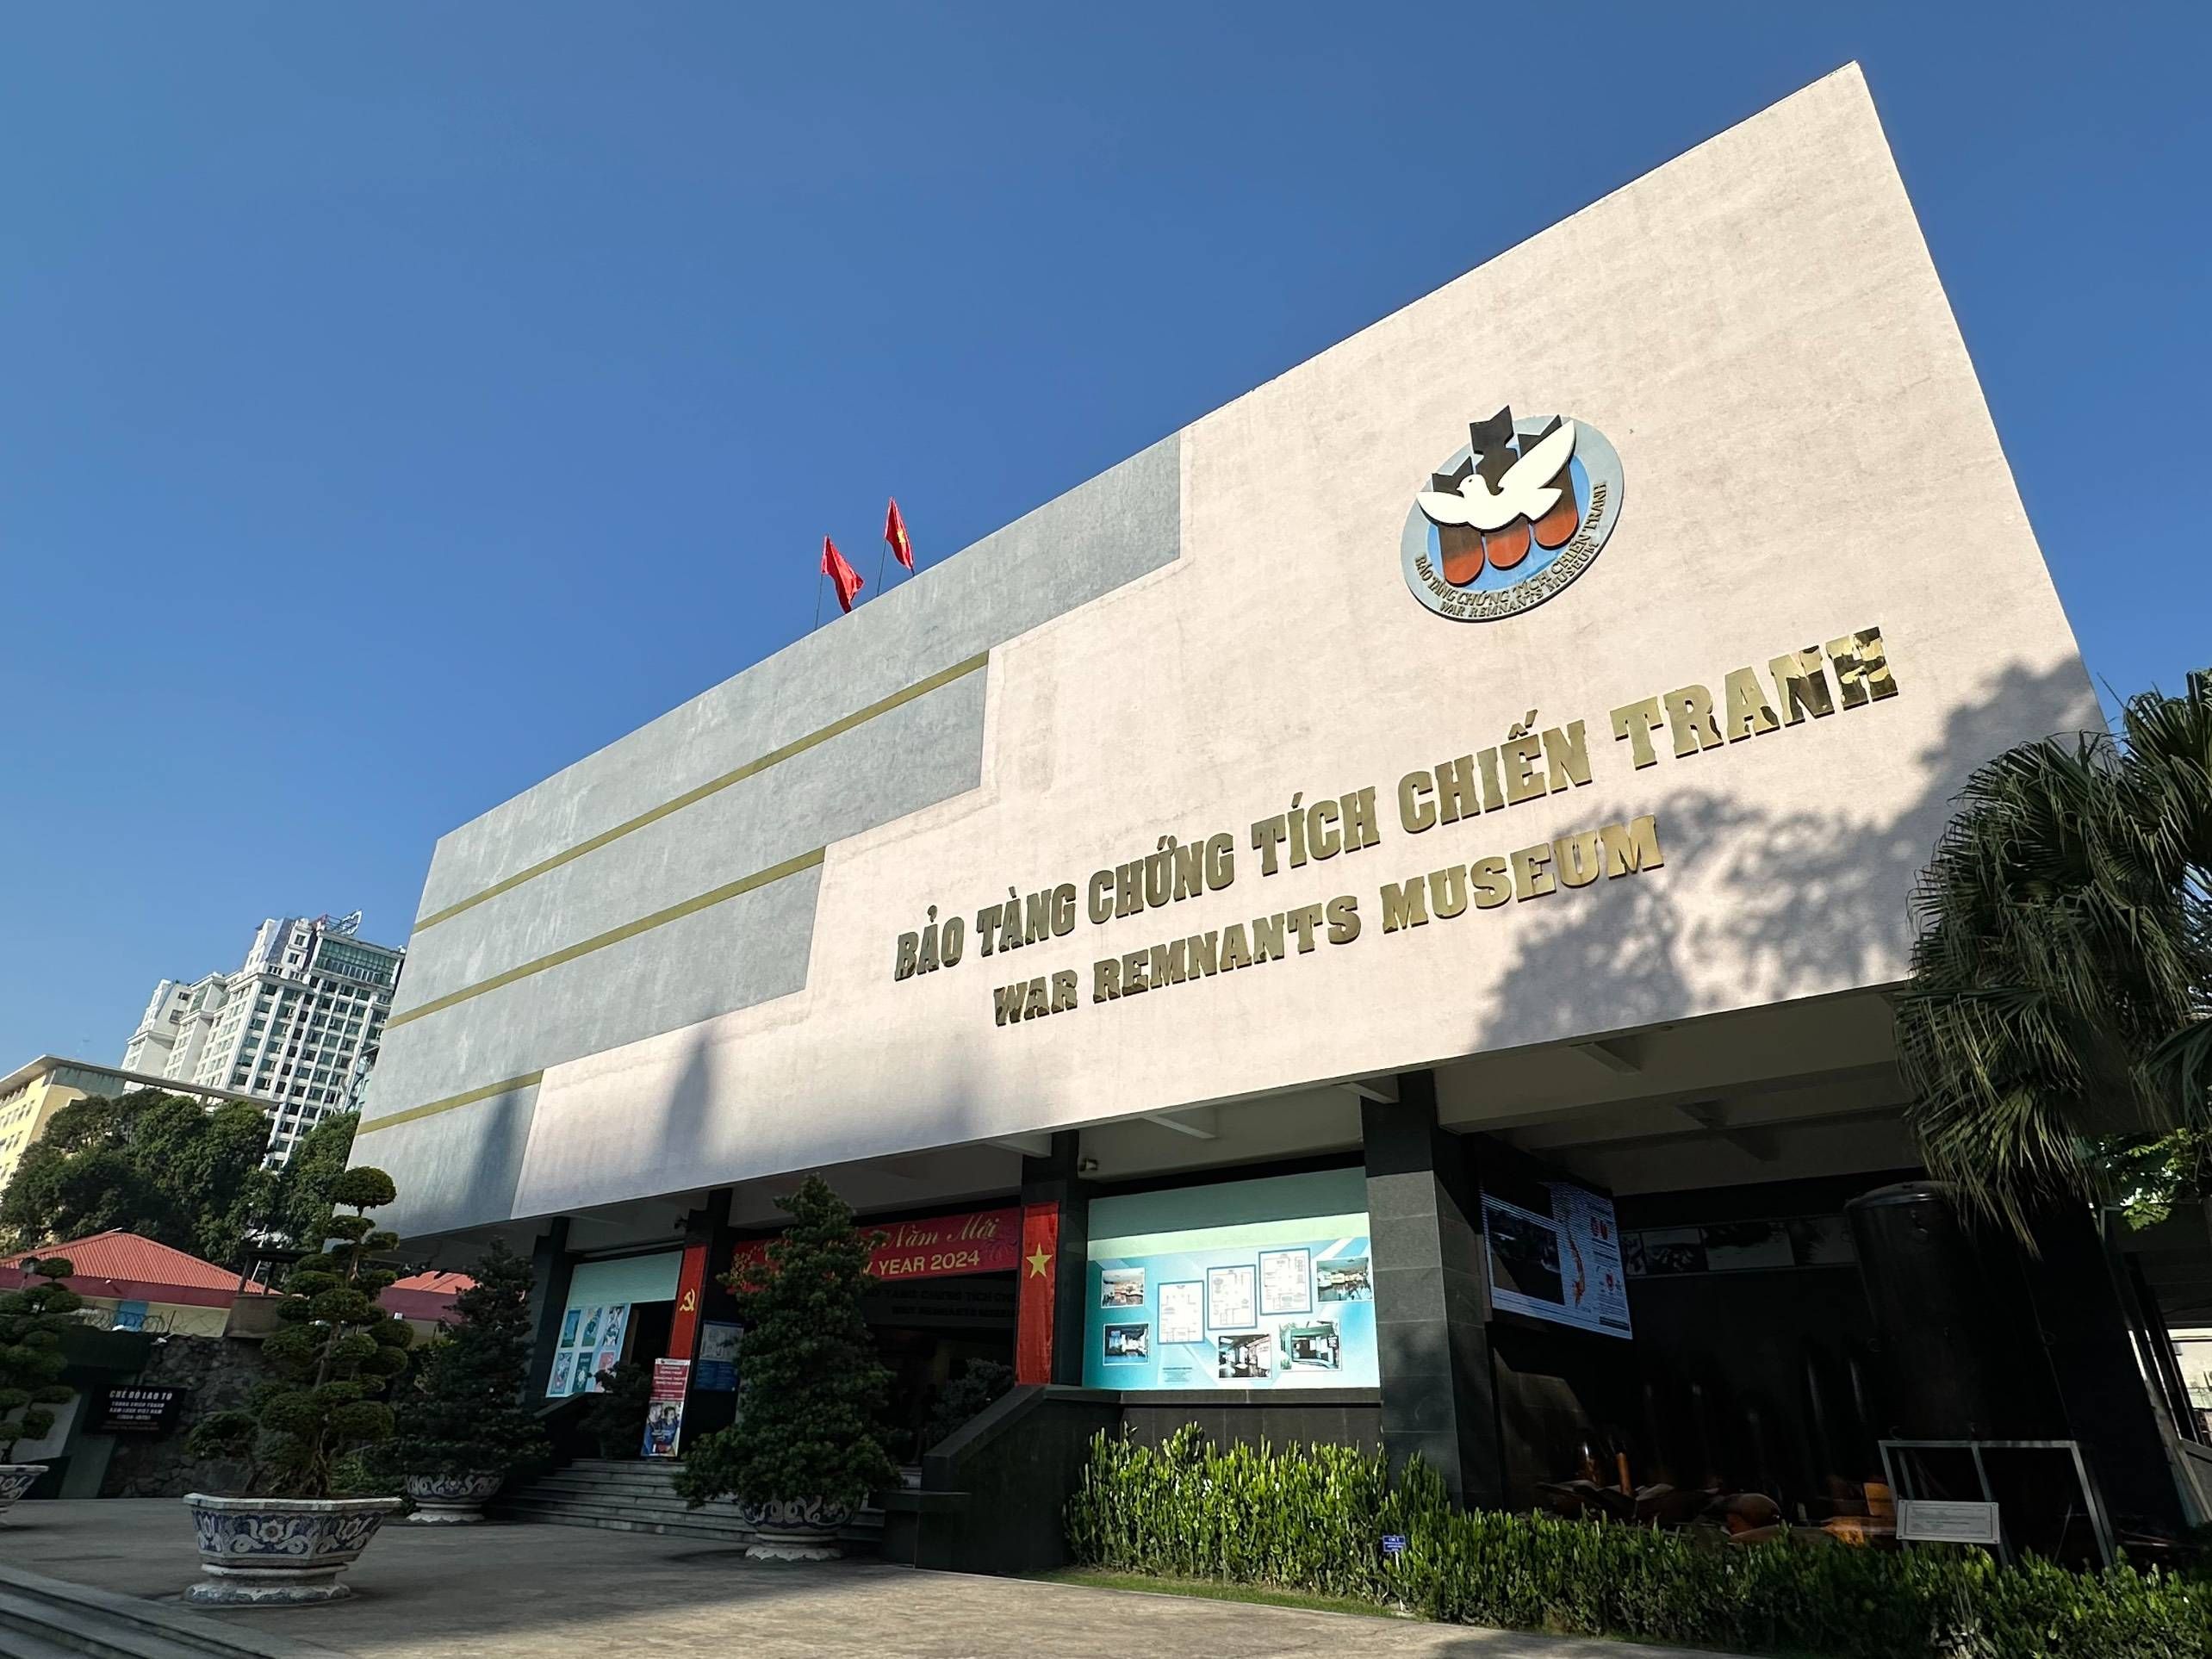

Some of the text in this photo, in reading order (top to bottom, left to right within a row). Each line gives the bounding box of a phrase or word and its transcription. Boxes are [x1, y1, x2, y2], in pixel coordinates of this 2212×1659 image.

[1439, 542, 1600, 618] WAR REMNANTS MUSEUM
[894, 626, 1899, 981] BẢO TÀNG CHỨNG TÍCH CHIẾN TRANH
[993, 814, 1664, 1027] WAR REMNANTS MUSEUM
[879, 1257, 925, 1276] YEAR
[930, 1250, 980, 1271] 2024
[881, 1224, 939, 1248] Năm
